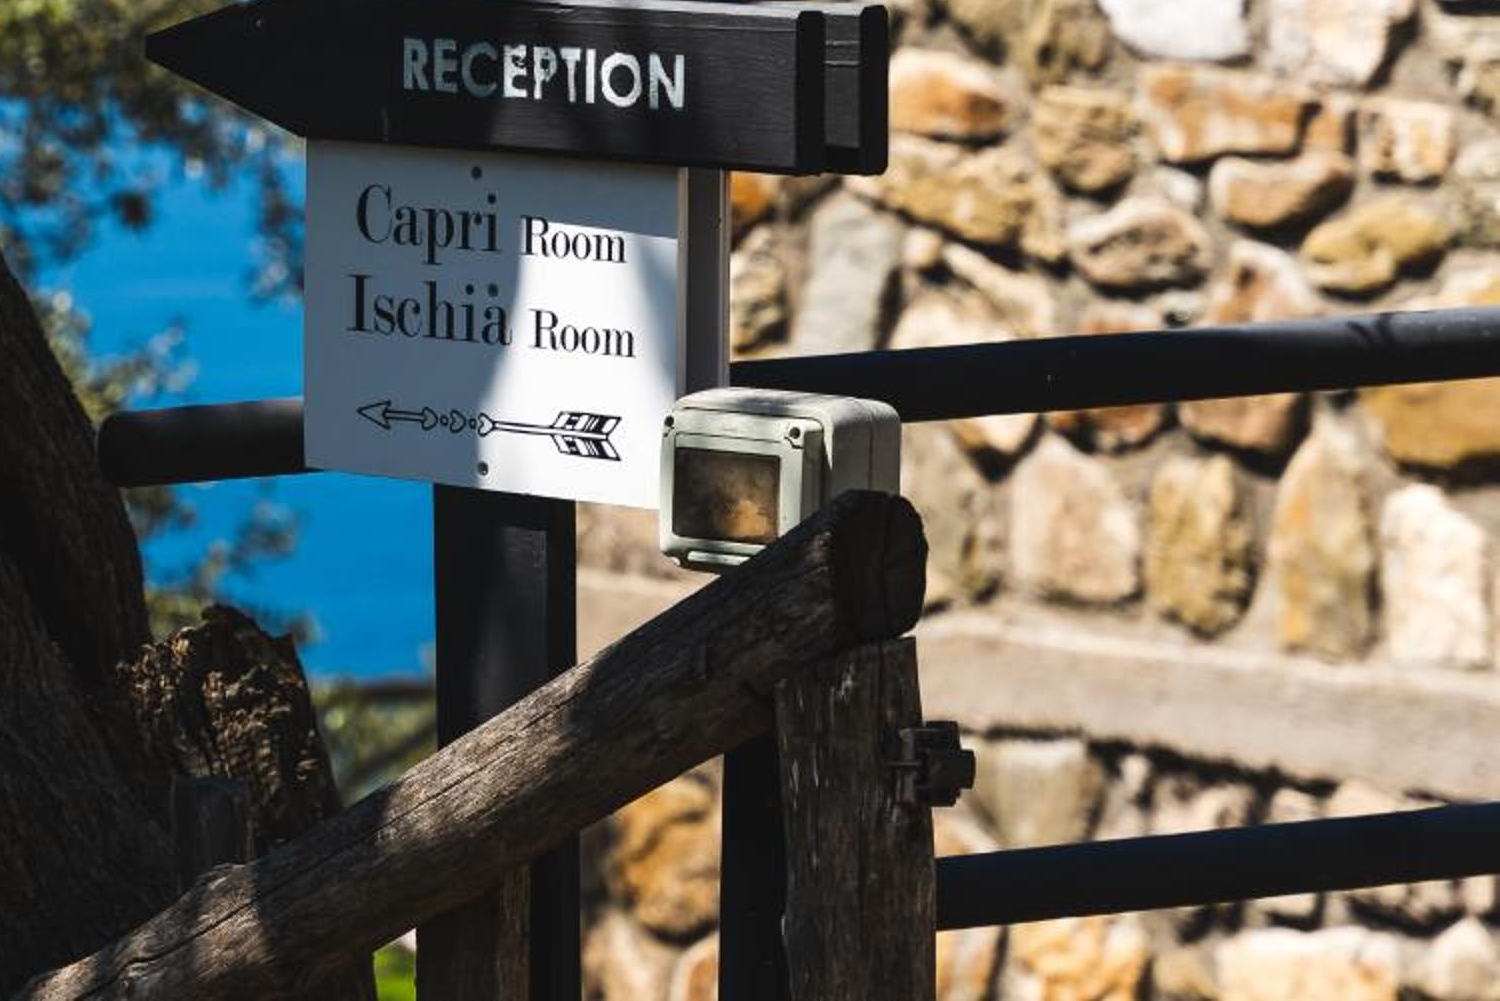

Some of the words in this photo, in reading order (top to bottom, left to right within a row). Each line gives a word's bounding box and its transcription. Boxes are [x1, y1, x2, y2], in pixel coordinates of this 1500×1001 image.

[402, 37, 686, 111] RECEPTION
[357, 183, 501, 265] Capri
[521, 214, 627, 263] Room
[348, 274, 512, 346] Ischia
[529, 308, 636, 358] Room
